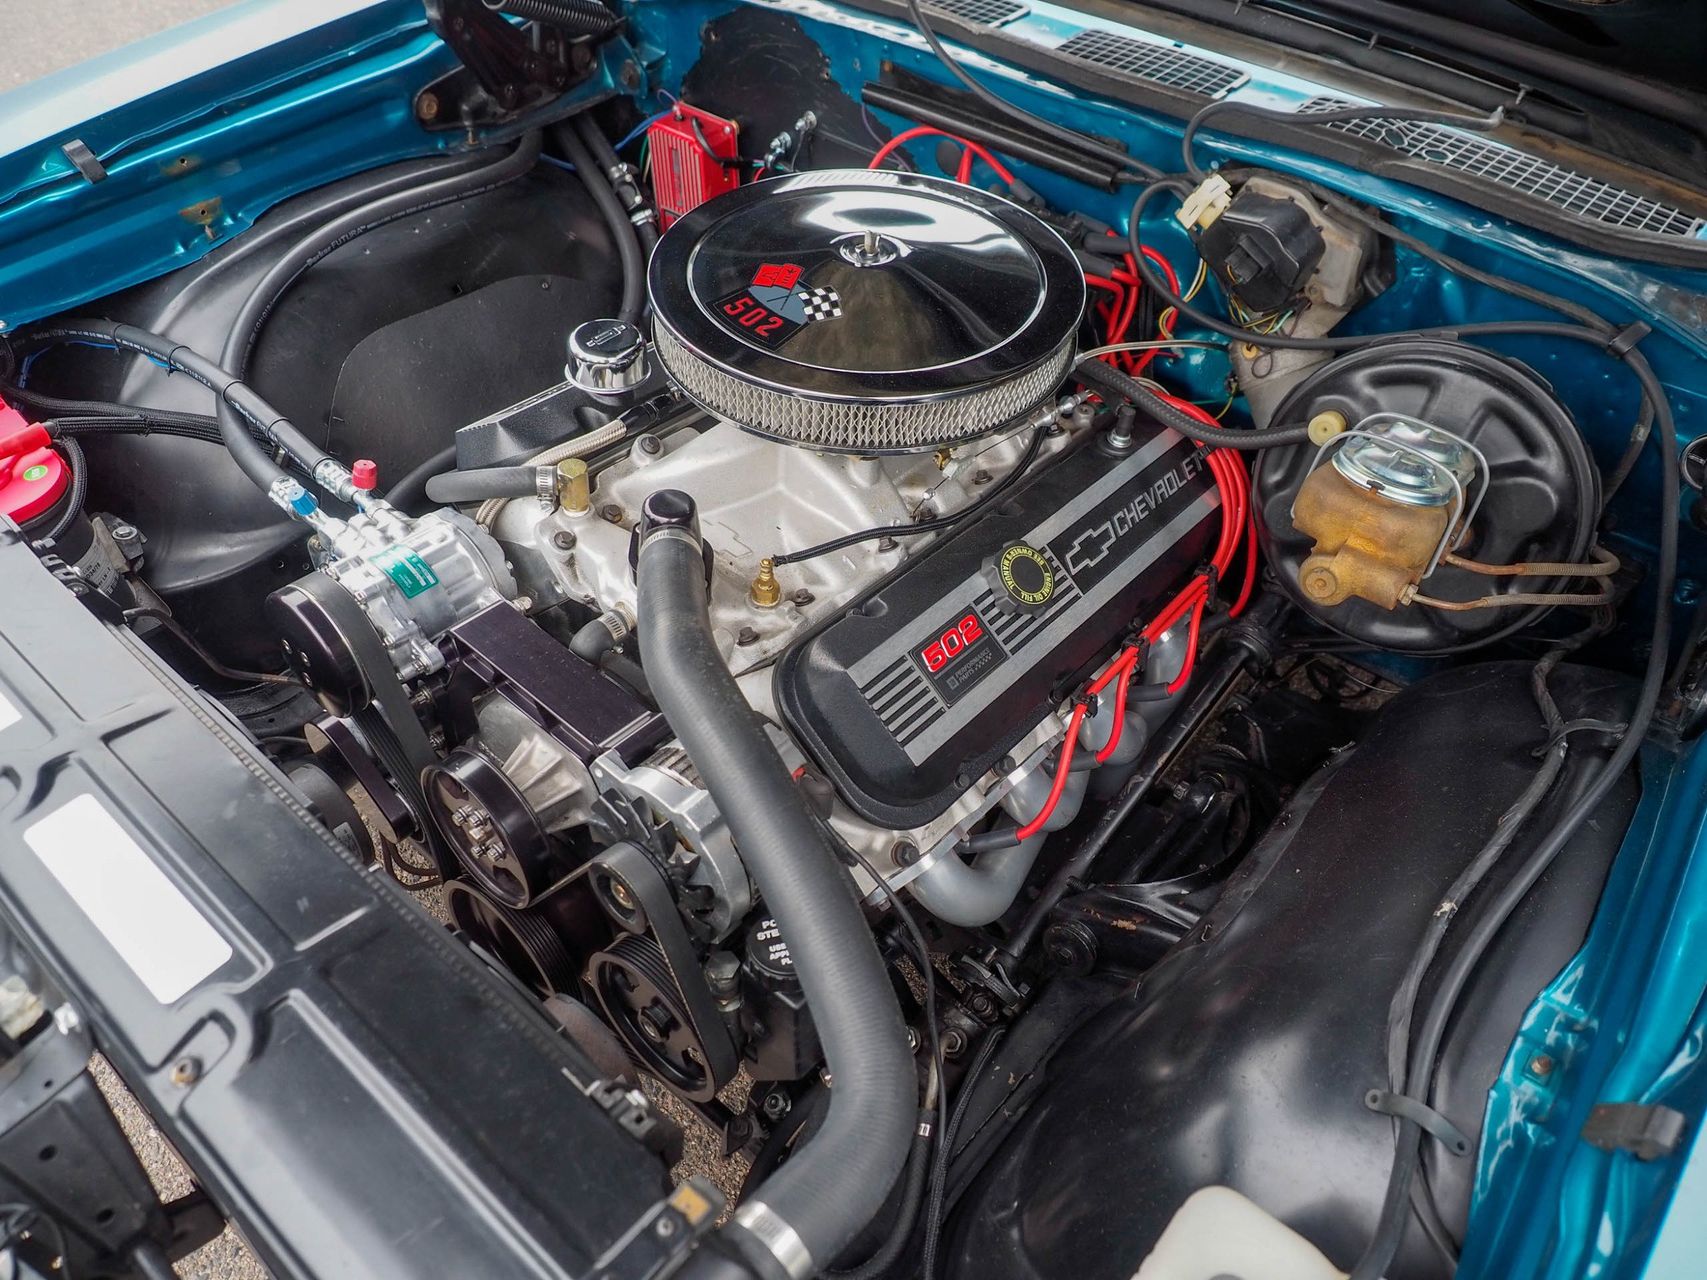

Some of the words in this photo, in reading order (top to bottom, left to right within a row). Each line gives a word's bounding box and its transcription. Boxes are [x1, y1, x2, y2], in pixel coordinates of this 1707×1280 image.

[723, 297, 783, 337] 502
[1113, 451, 1203, 536] CHEVROLET
[1003, 558, 1015, 589] MANUAL
[1034, 554, 1044, 565] SEE
[1021, 592, 1033, 601] FILL
[1043, 572, 1051, 597] ENGINE
[921, 614, 983, 673] 502
